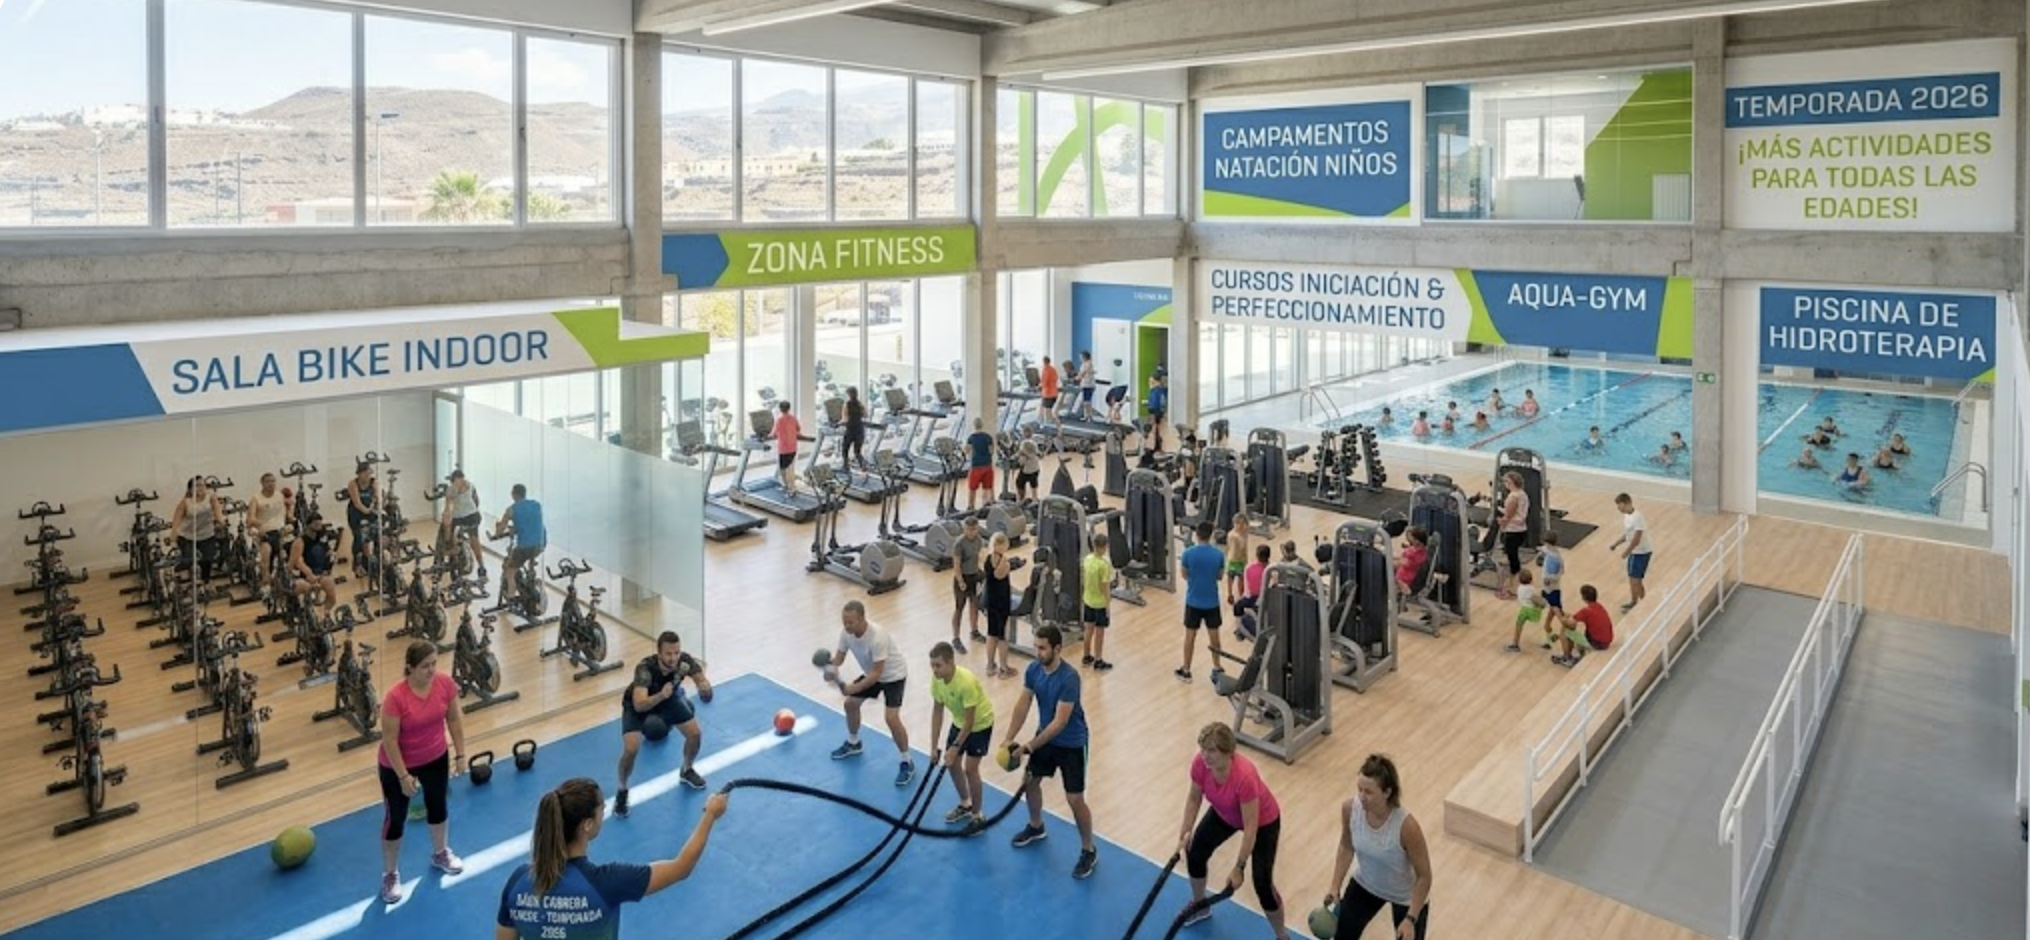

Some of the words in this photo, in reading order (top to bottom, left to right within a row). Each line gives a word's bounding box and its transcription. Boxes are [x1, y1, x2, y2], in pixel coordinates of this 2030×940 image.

[1735, 89, 1902, 118] TEMPORADA
[1910, 84, 1988, 111] 2026
[1222, 120, 1389, 149] CAMPAMENTOS
[1738, 134, 1802, 165] ¡MÁS
[1809, 131, 1992, 159] ACTIVIDADES
[1215, 149, 1318, 178] NATACIÓN
[1325, 148, 1399, 175] NIÑOS
[1751, 166, 1818, 190] PARA
[1826, 165, 1916, 188] TODAS
[1924, 164, 1978, 187] LAS
[1803, 196, 1918, 219] EDADES!
[747, 242, 826, 274] ZONA
[835, 236, 944, 268] FITNESS
[1211, 268, 1295, 294] CURSOS
[1299, 270, 1420, 299] INICIACIÓN
[1427, 277, 1446, 301] &
[1507, 283, 1647, 311] AQUA-GYM
[1211, 295, 1446, 330] PERFECCIONAMIENTO
[1794, 296, 1911, 325] PISCINA
[1920, 303, 1959, 327] DE
[1770, 326, 1986, 362] HIDROTERAPIA
[172, 352, 284, 395] SALA
[298, 342, 391, 383] BIKE
[404, 329, 549, 373] INDOOR
